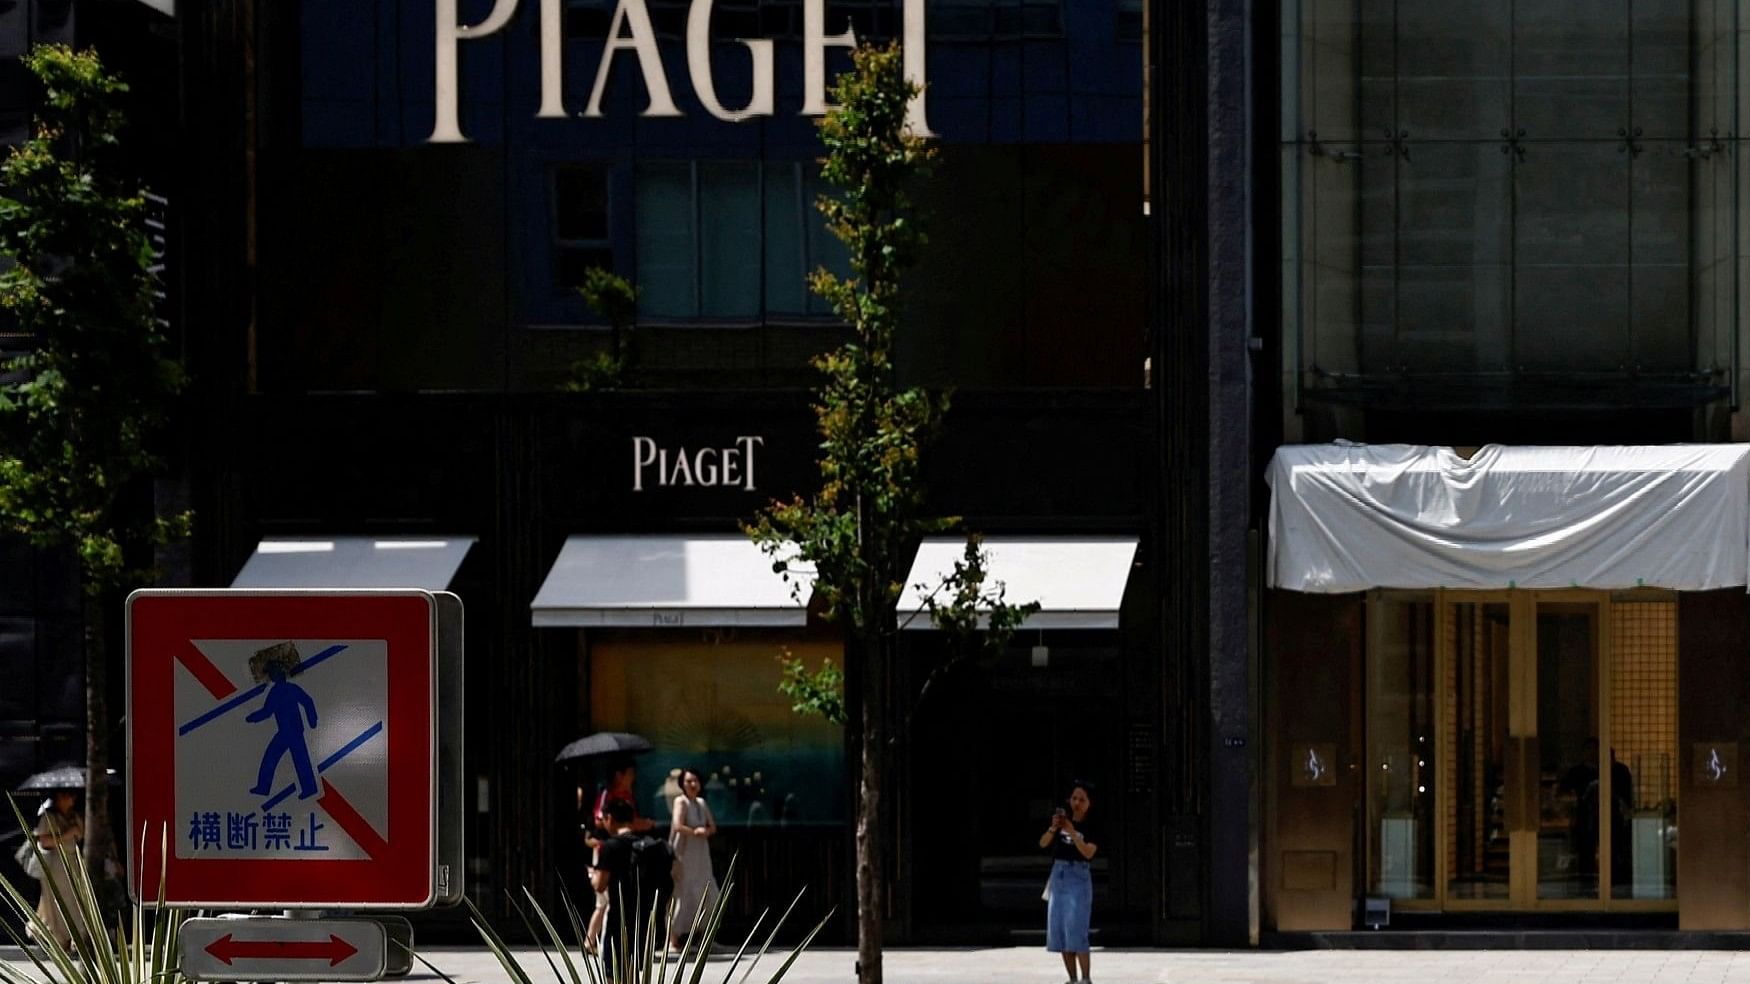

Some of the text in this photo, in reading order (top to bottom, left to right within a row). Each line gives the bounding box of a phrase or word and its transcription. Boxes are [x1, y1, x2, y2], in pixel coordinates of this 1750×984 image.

[632, 436, 764, 491] PIAGET
[188, 811, 329, 851] 横断禁止
